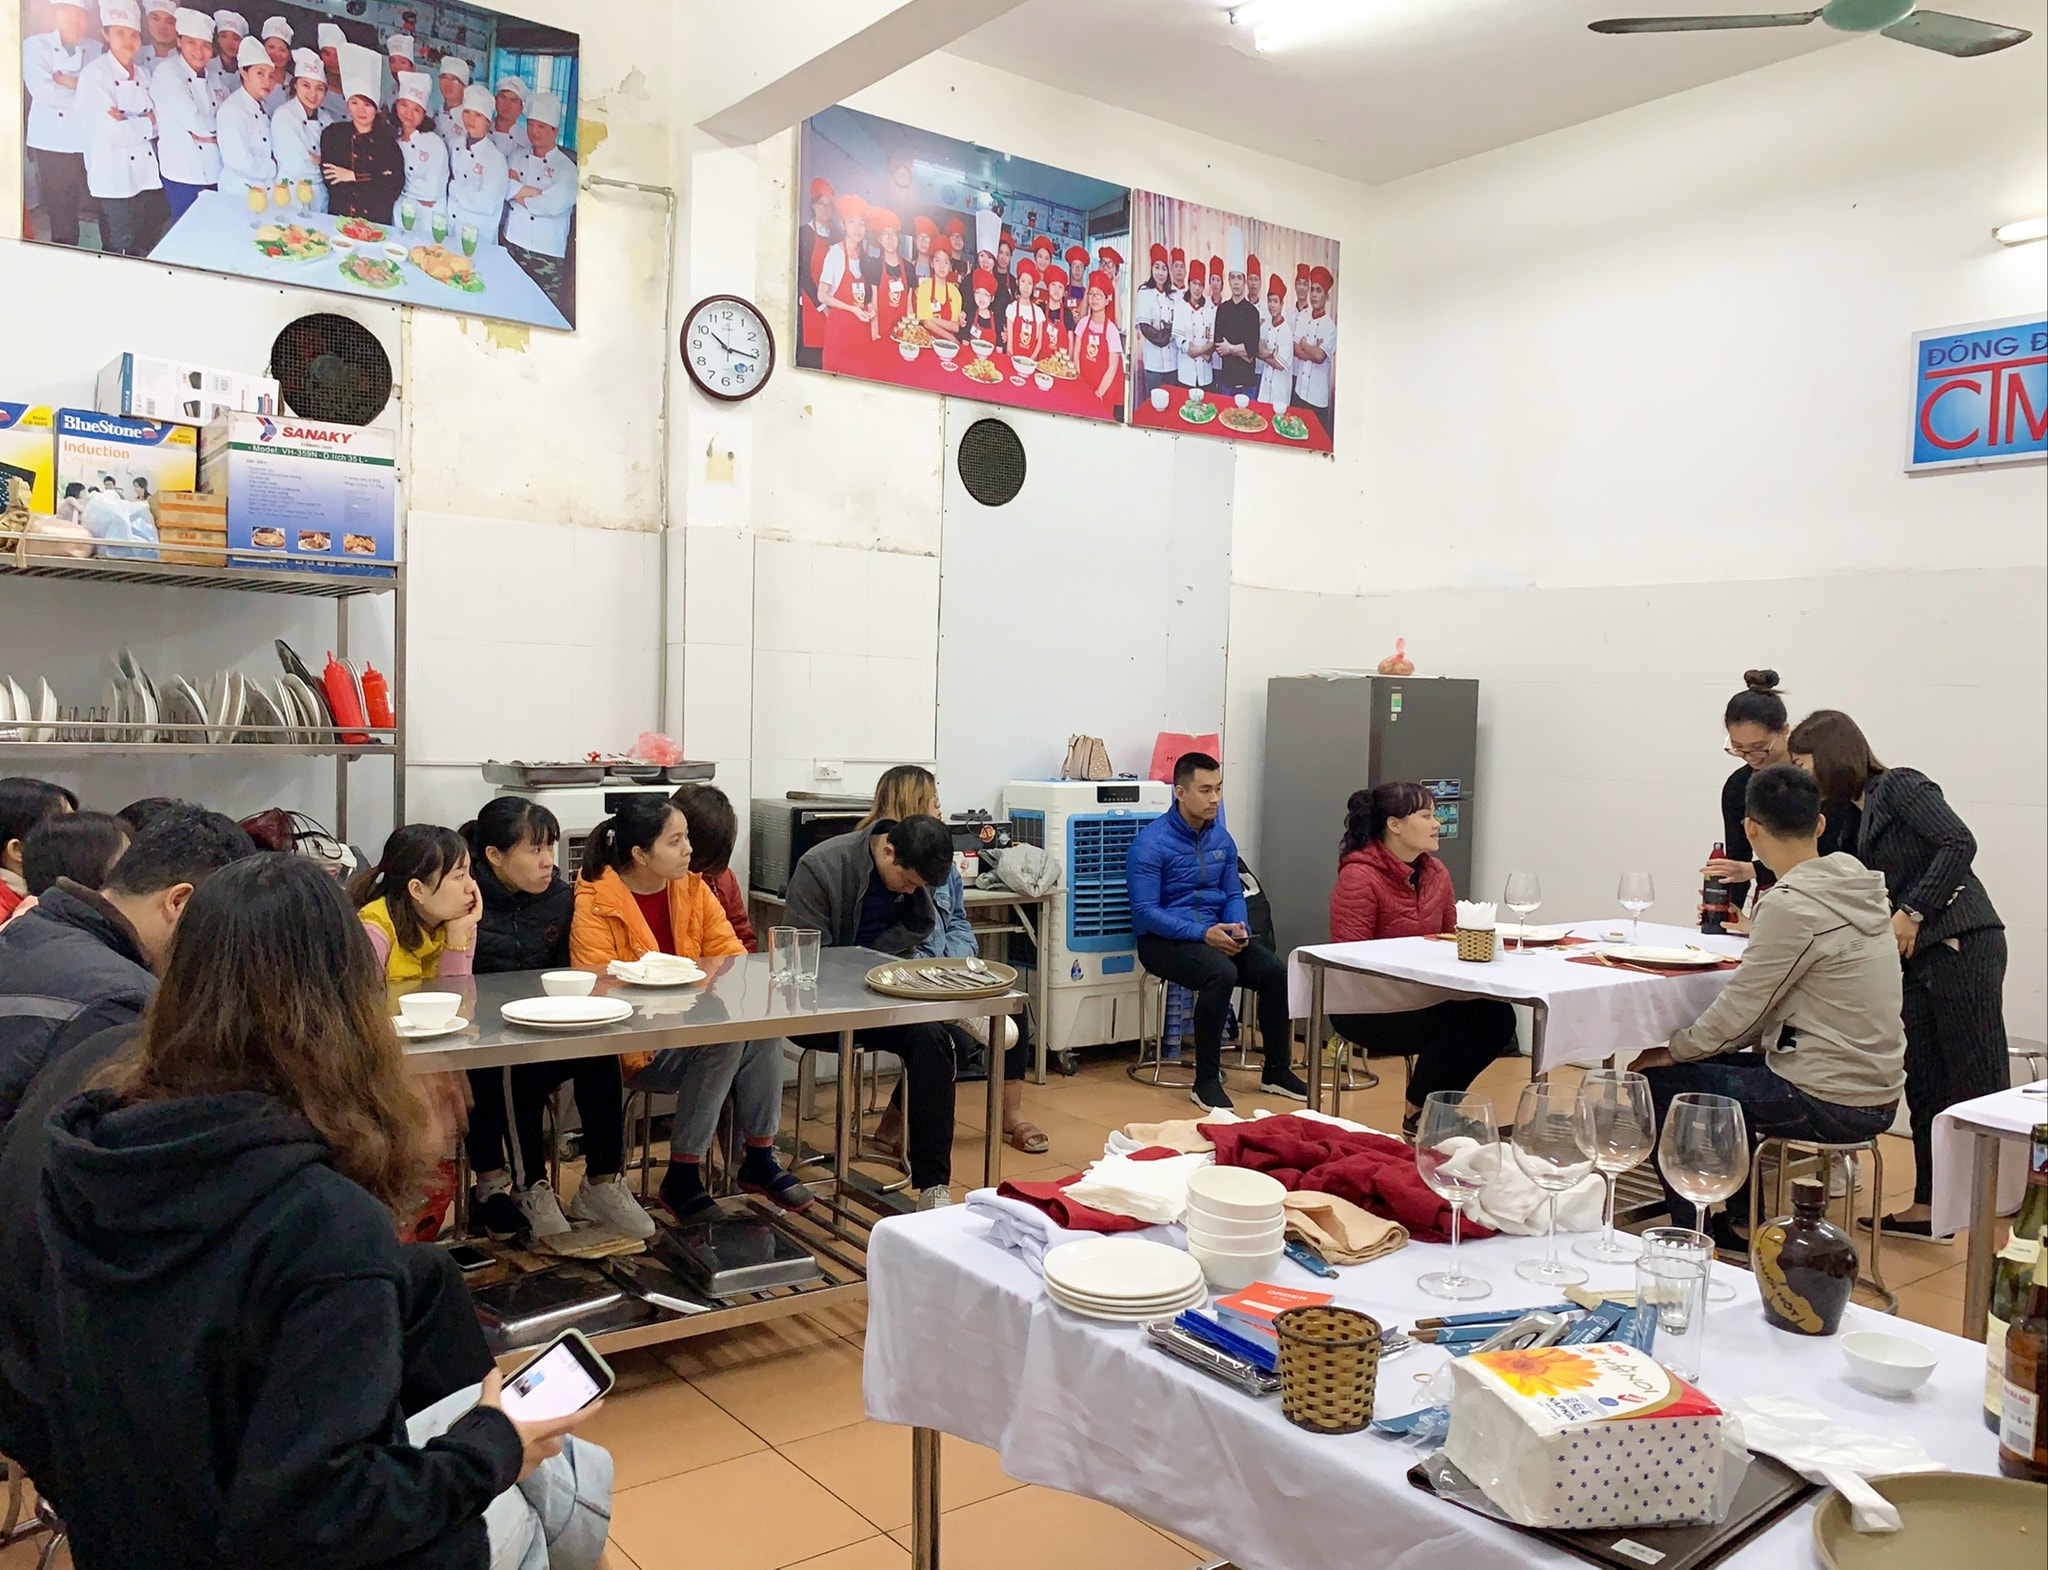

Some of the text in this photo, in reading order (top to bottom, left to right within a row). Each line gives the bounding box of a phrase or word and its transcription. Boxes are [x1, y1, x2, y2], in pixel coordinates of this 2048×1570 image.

[709, 314, 717, 323] 11
[722, 311, 734, 320] 12
[741, 318, 745, 327] 1
[697, 325, 709, 335] 10
[747, 332, 756, 341] 2
[693, 340, 702, 349] 9
[751, 348, 760, 357] 3
[697, 356, 706, 366] 8
[748, 364, 755, 373] 4
[707, 370, 715, 379] 7
[721, 377, 730, 386] 6
[736, 375, 745, 384] 5
[1920, 355, 2048, 450] CTM
[63, 414, 143, 439] BlueStone
[282, 426, 353, 444] SANAKY
[63, 440, 130, 459] Induction
[1266, 1289, 1308, 1301] ORDER
[1547, 1397, 1579, 1421] NAPKIN
